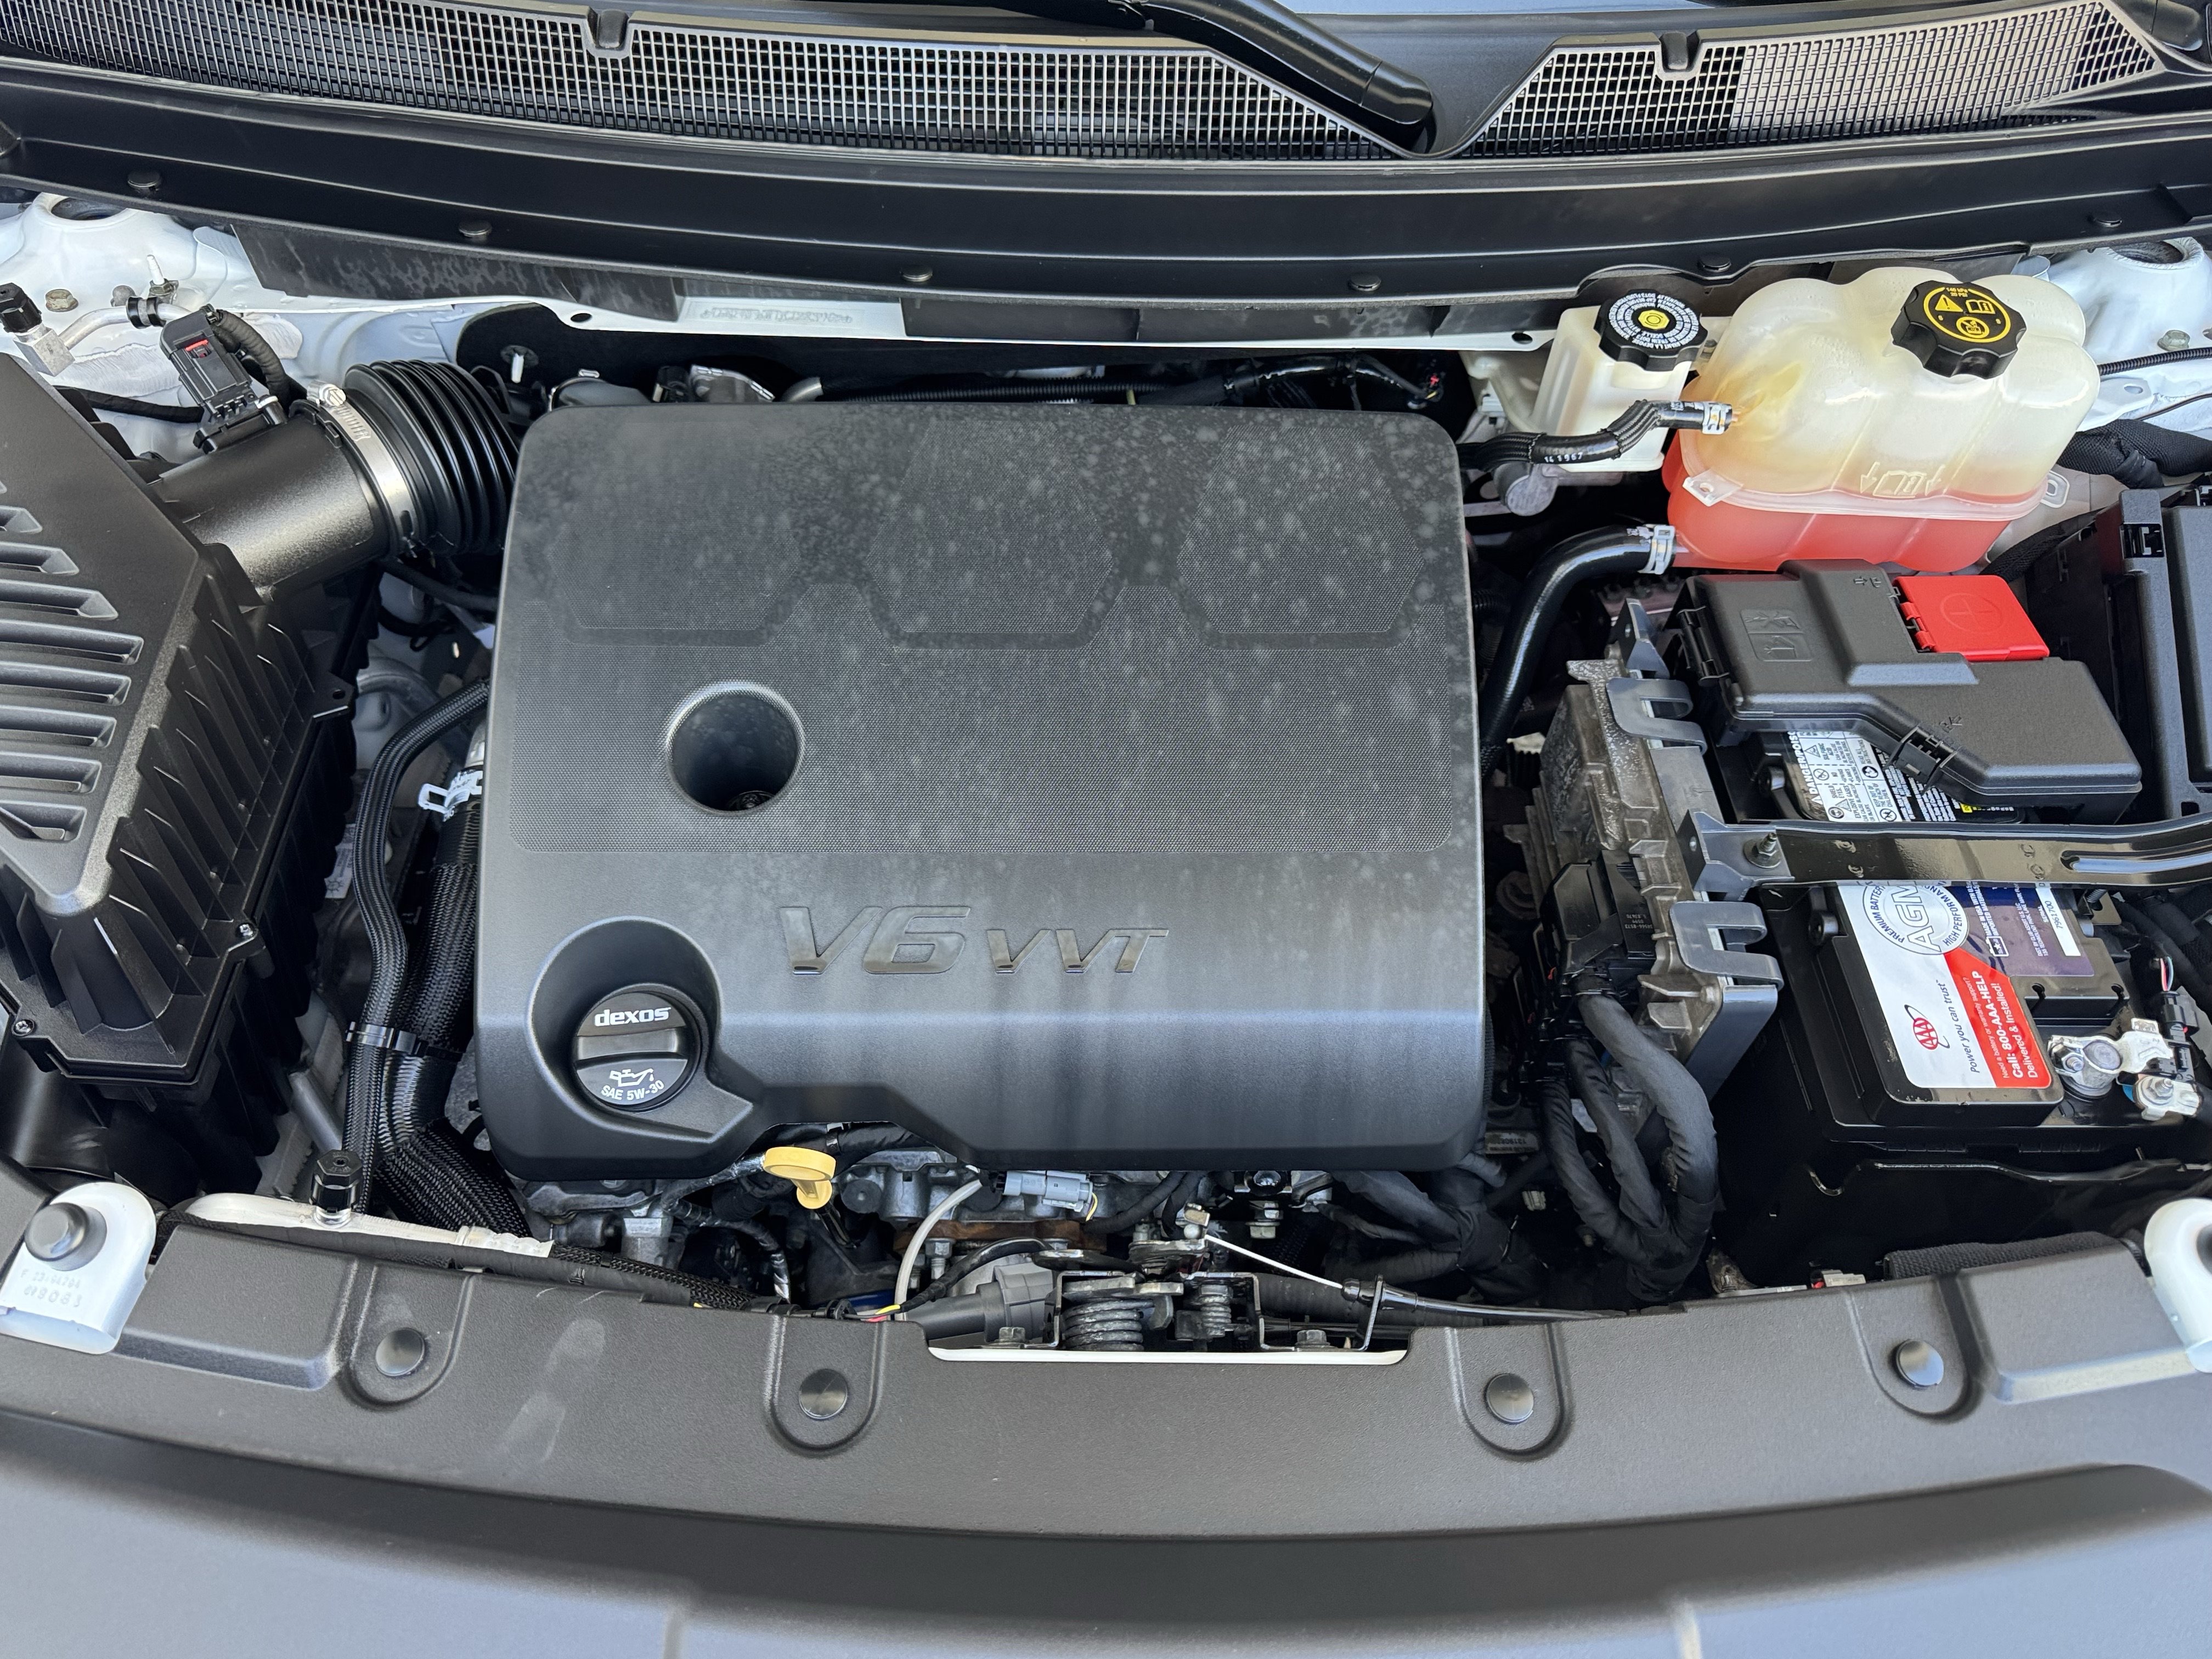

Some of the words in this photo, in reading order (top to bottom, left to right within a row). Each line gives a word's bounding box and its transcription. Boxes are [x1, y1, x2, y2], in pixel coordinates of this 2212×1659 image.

[1891, 885, 1942, 952] AGM
[2037, 905, 2049, 923] SERIAL
[2045, 900, 2063, 929] 7961700
[1872, 912, 1905, 943] PREMIUM
[1943, 930, 1960, 946] HIGH
[778, 906, 971, 975] V6
[985, 928, 1169, 974] VVT
[1962, 977, 1978, 1001] support?
[1948, 1006, 1960, 1023] can
[1971, 970, 2012, 1051] 800-AAA-HELP
[1975, 1002, 1989, 1028] warranty
[1990, 983, 2015, 1024] Installed!
[595, 1007, 672, 1027] dexos
[2008, 1025, 2019, 1034] &
[1913, 1019, 1938, 1049] AAA
[1955, 1024, 1970, 1043] you
[1989, 1035, 2000, 1057] battery
[2006, 1053, 2024, 1079] Call:
[2011, 1035, 2039, 1078] Delivered
[1997, 1062, 2010, 1079] Need
[601, 1085, 624, 1101] SAE
[627, 1080, 664, 1101] 5W-30
